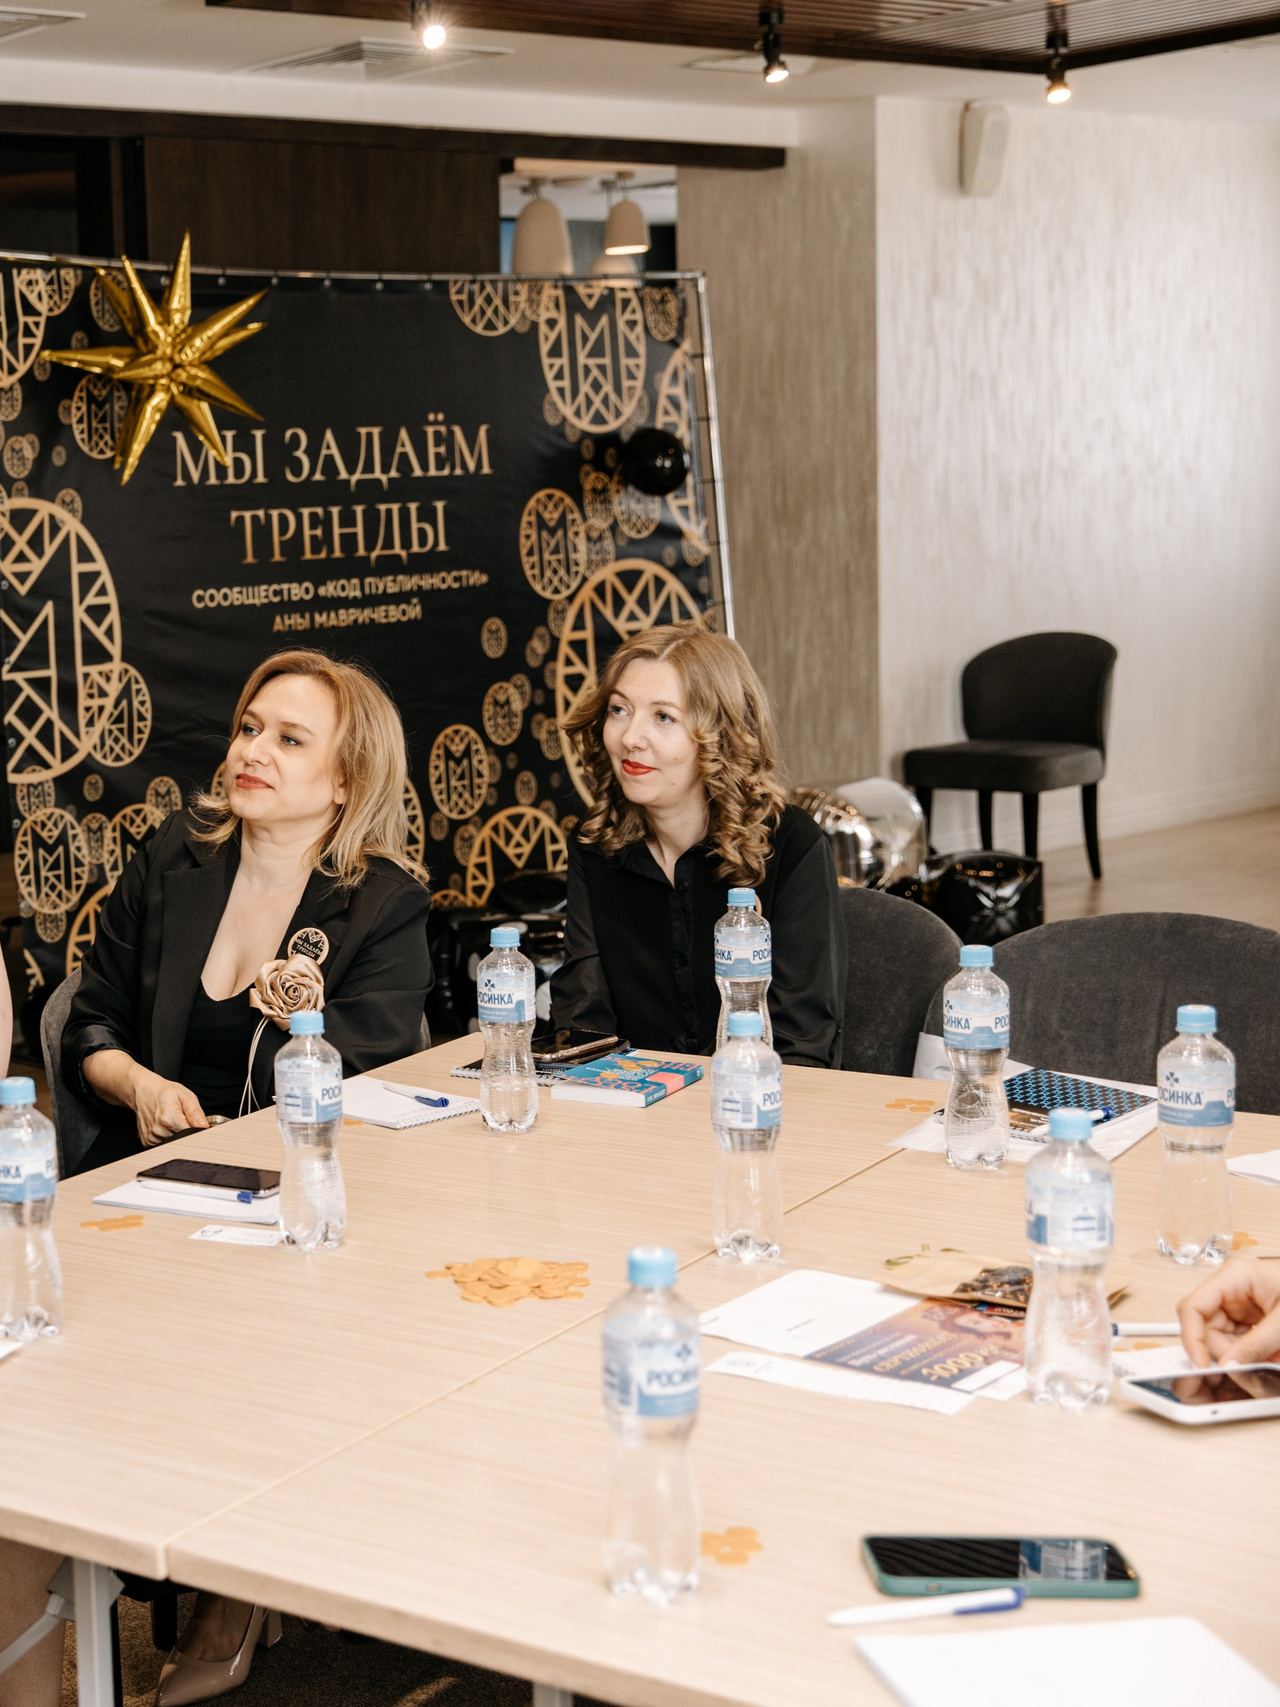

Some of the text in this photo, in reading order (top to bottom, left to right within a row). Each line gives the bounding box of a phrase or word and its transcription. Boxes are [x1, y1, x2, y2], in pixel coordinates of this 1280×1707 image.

[172, 412, 495, 492] МЫ ЗАДАЁМ
[230, 501, 451, 568] ТРЕНДЫ
[192, 569, 490, 608] СООБЩЕСТВО «КОД ПУБЛИЧНОСТИ»
[273, 597, 423, 633] АНЫ МАВРИЧЕВОЙ
